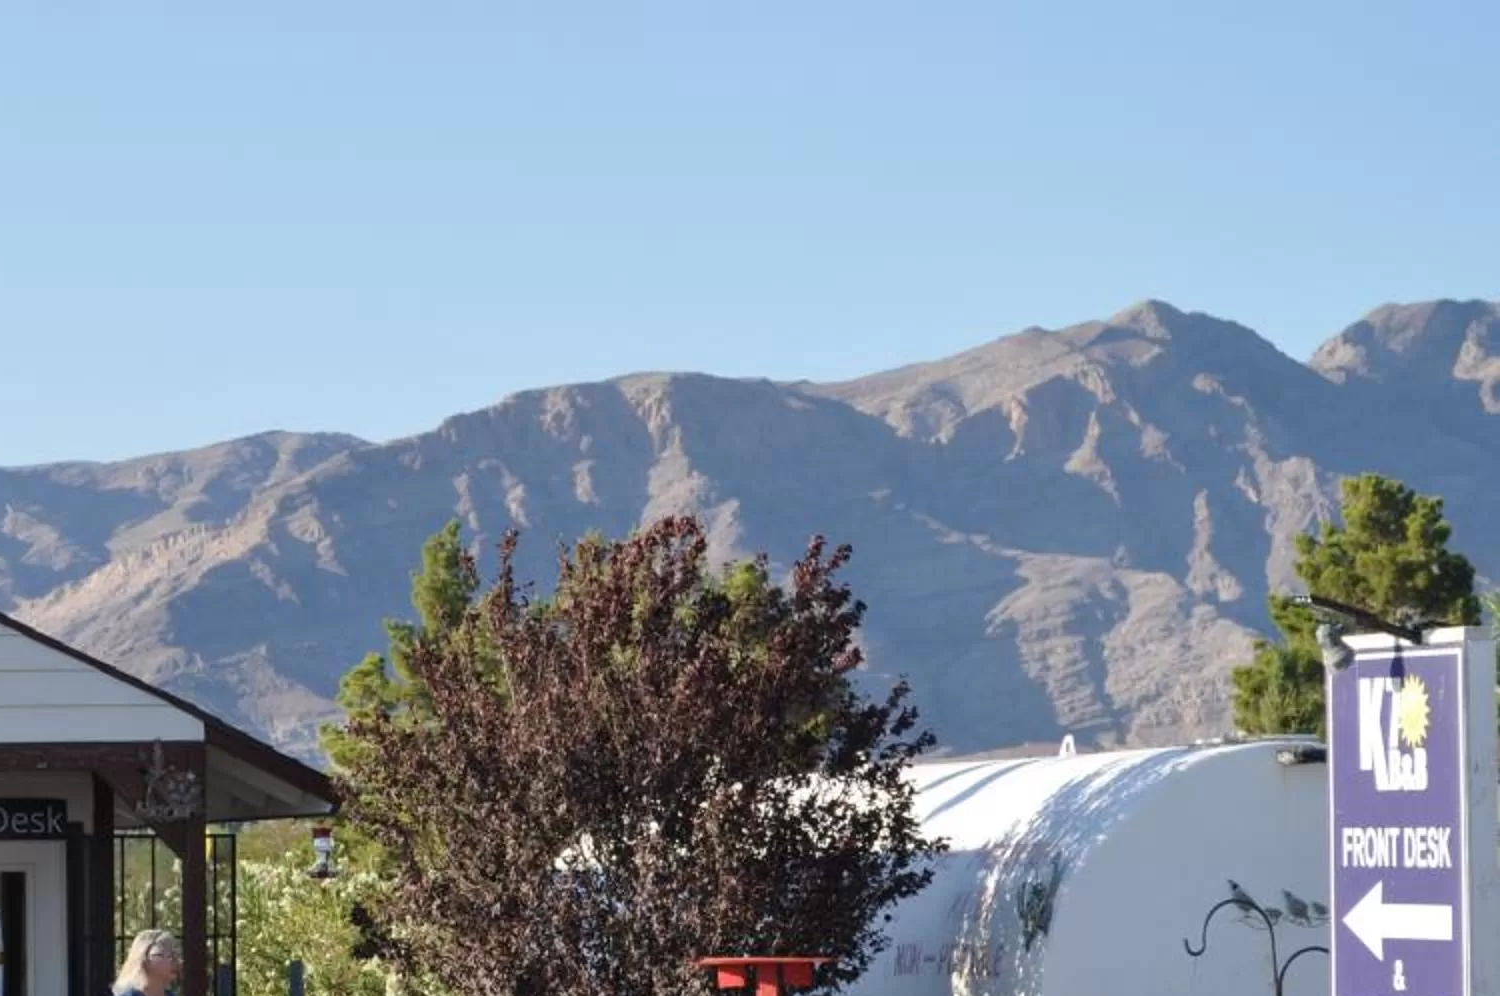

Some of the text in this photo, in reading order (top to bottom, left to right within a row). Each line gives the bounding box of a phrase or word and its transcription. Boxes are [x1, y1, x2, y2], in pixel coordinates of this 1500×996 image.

[1342, 826, 1453, 870] FRONT DESK
[1392, 959, 1407, 992] &
